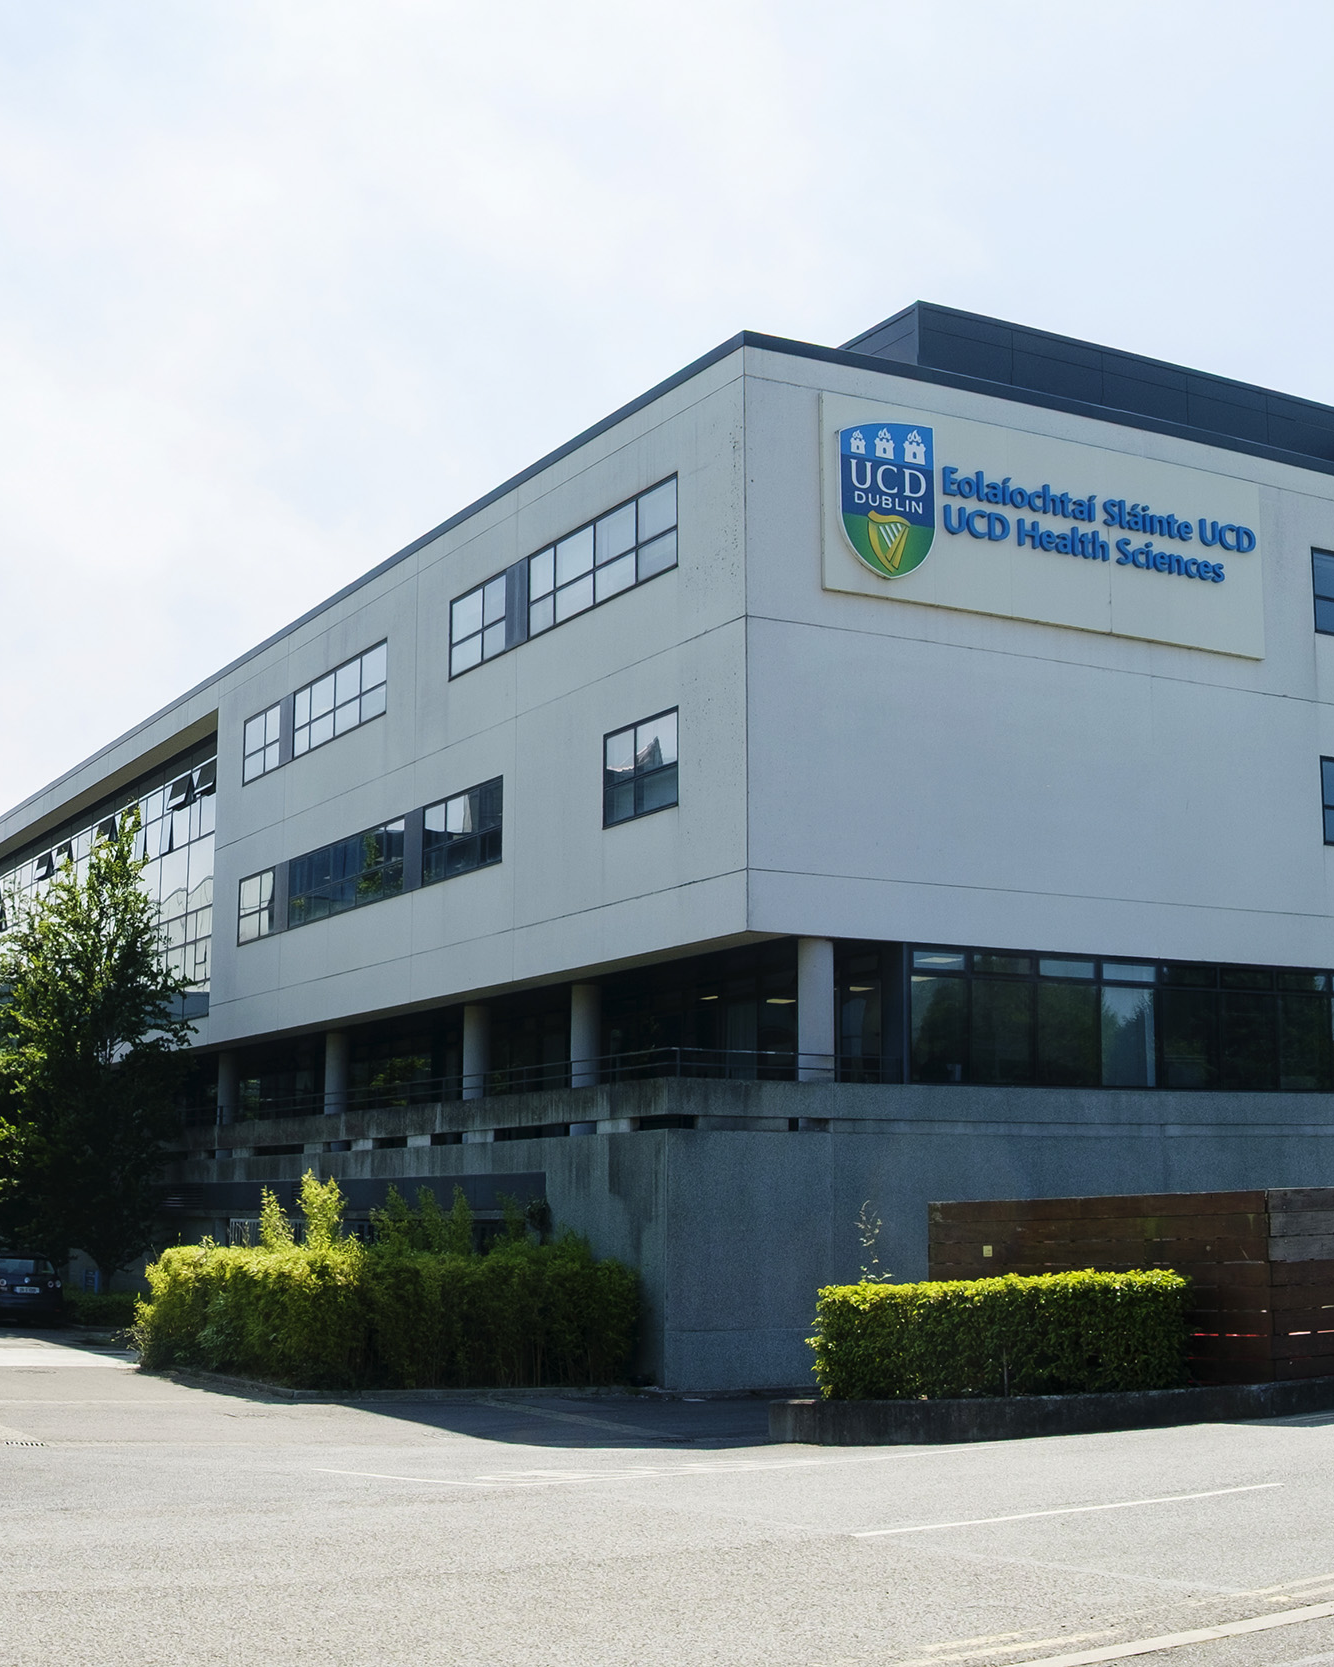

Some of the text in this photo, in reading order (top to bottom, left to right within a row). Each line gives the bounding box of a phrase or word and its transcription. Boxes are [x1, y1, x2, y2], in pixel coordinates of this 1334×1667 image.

[850, 458, 927, 498] UCD
[854, 490, 923, 514] DUBLIN
[942, 465, 1257, 553] Eolaíochtaí Sláinte UCD
[943, 504, 1226, 584] UCD Health Sciences
